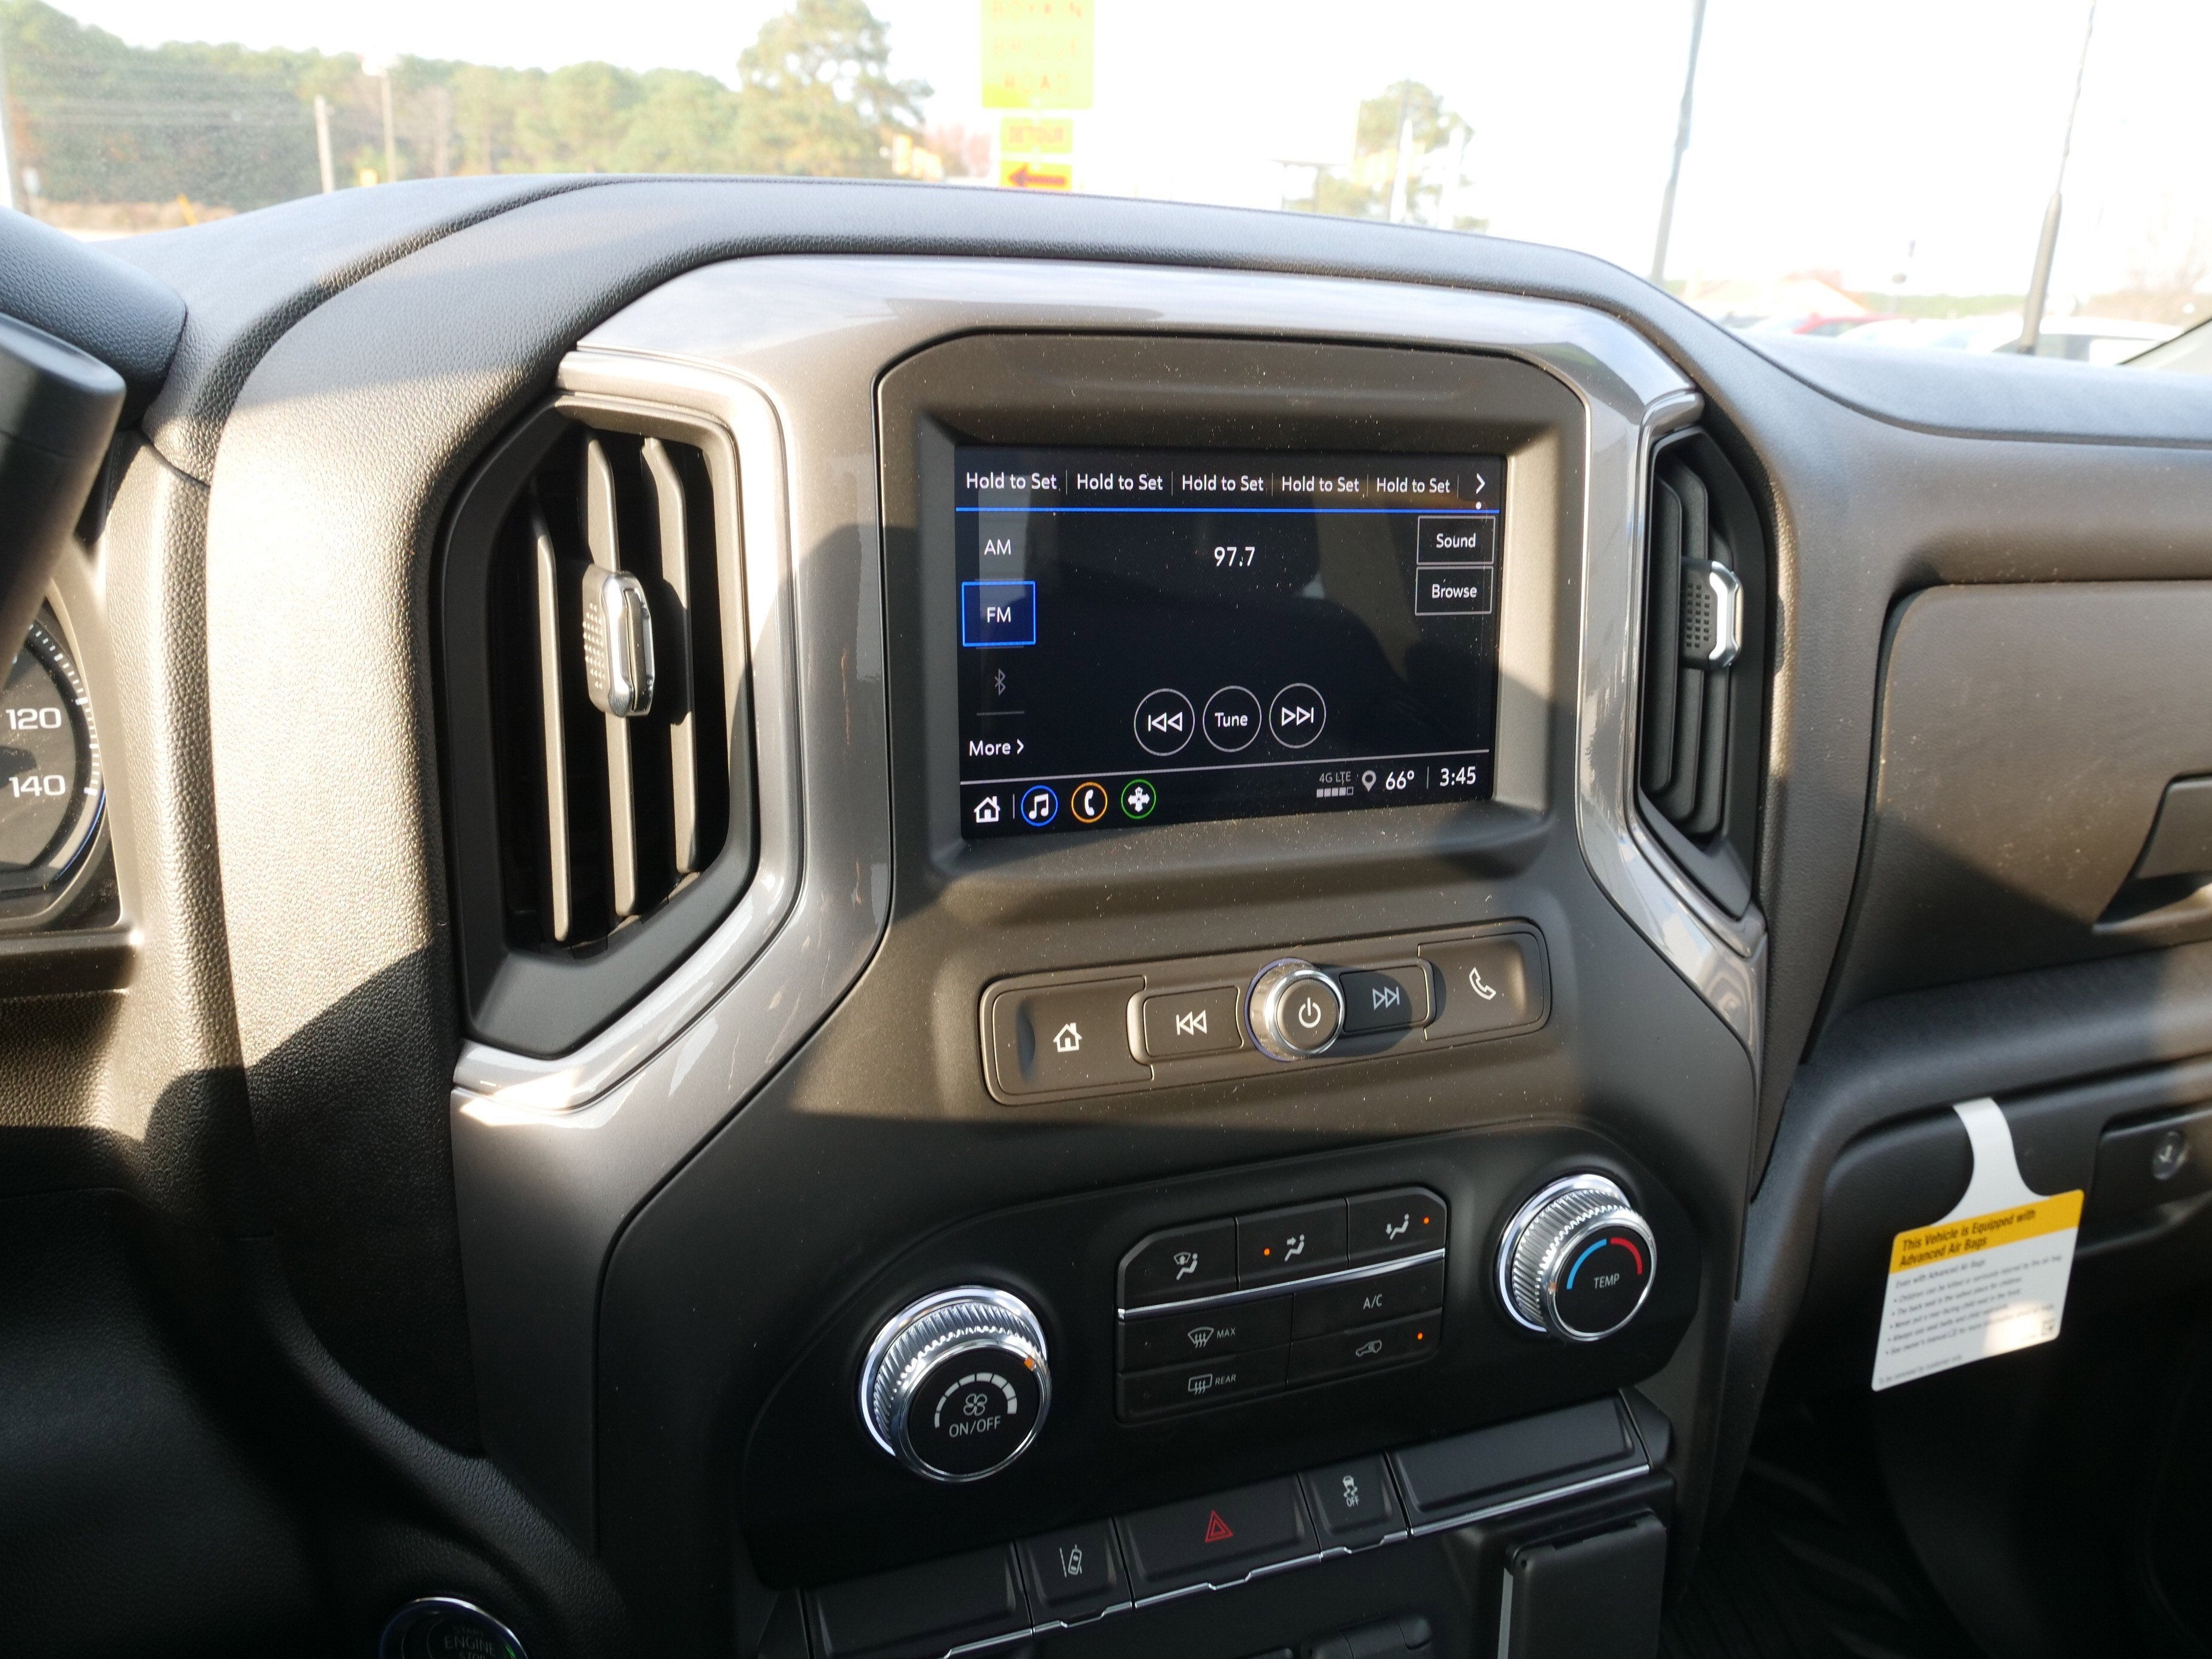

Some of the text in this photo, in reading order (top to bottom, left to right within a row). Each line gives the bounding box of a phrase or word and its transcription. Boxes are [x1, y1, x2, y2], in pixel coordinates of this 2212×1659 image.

[966, 472, 1057, 490] Hold to Set
[1077, 473, 1163, 490] Hold to Set
[1182, 474, 1264, 491] Hold to Set
[1282, 475, 1359, 492] Hold to Set
[1377, 476, 1450, 493] Hold to Set
[984, 539, 1012, 557] AM
[1436, 533, 1476, 549] Sound
[1214, 546, 1256, 567] 97.7
[1432, 584, 1477, 599] Browse
[987, 607, 1012, 623] FM
[6, 707, 61, 730] 120
[1214, 712, 1248, 728] Tune
[970, 740, 1011, 756] More
[1319, 771, 1352, 784] 4G LTE
[1440, 766, 1477, 785] 3:45
[9, 775, 66, 797] 140
[1903, 1208, 2035, 1250] This Vehicle is Equipped with
[1900, 1235, 1987, 1265] Advanced Air Bags
[1593, 1273, 1620, 1289] TEMP
[1363, 1294, 1382, 1310] A/C
[1217, 1328, 1236, 1339] MAX
[1214, 1374, 1237, 1385] REAR
[949, 1415, 1001, 1437] ON/OFF
